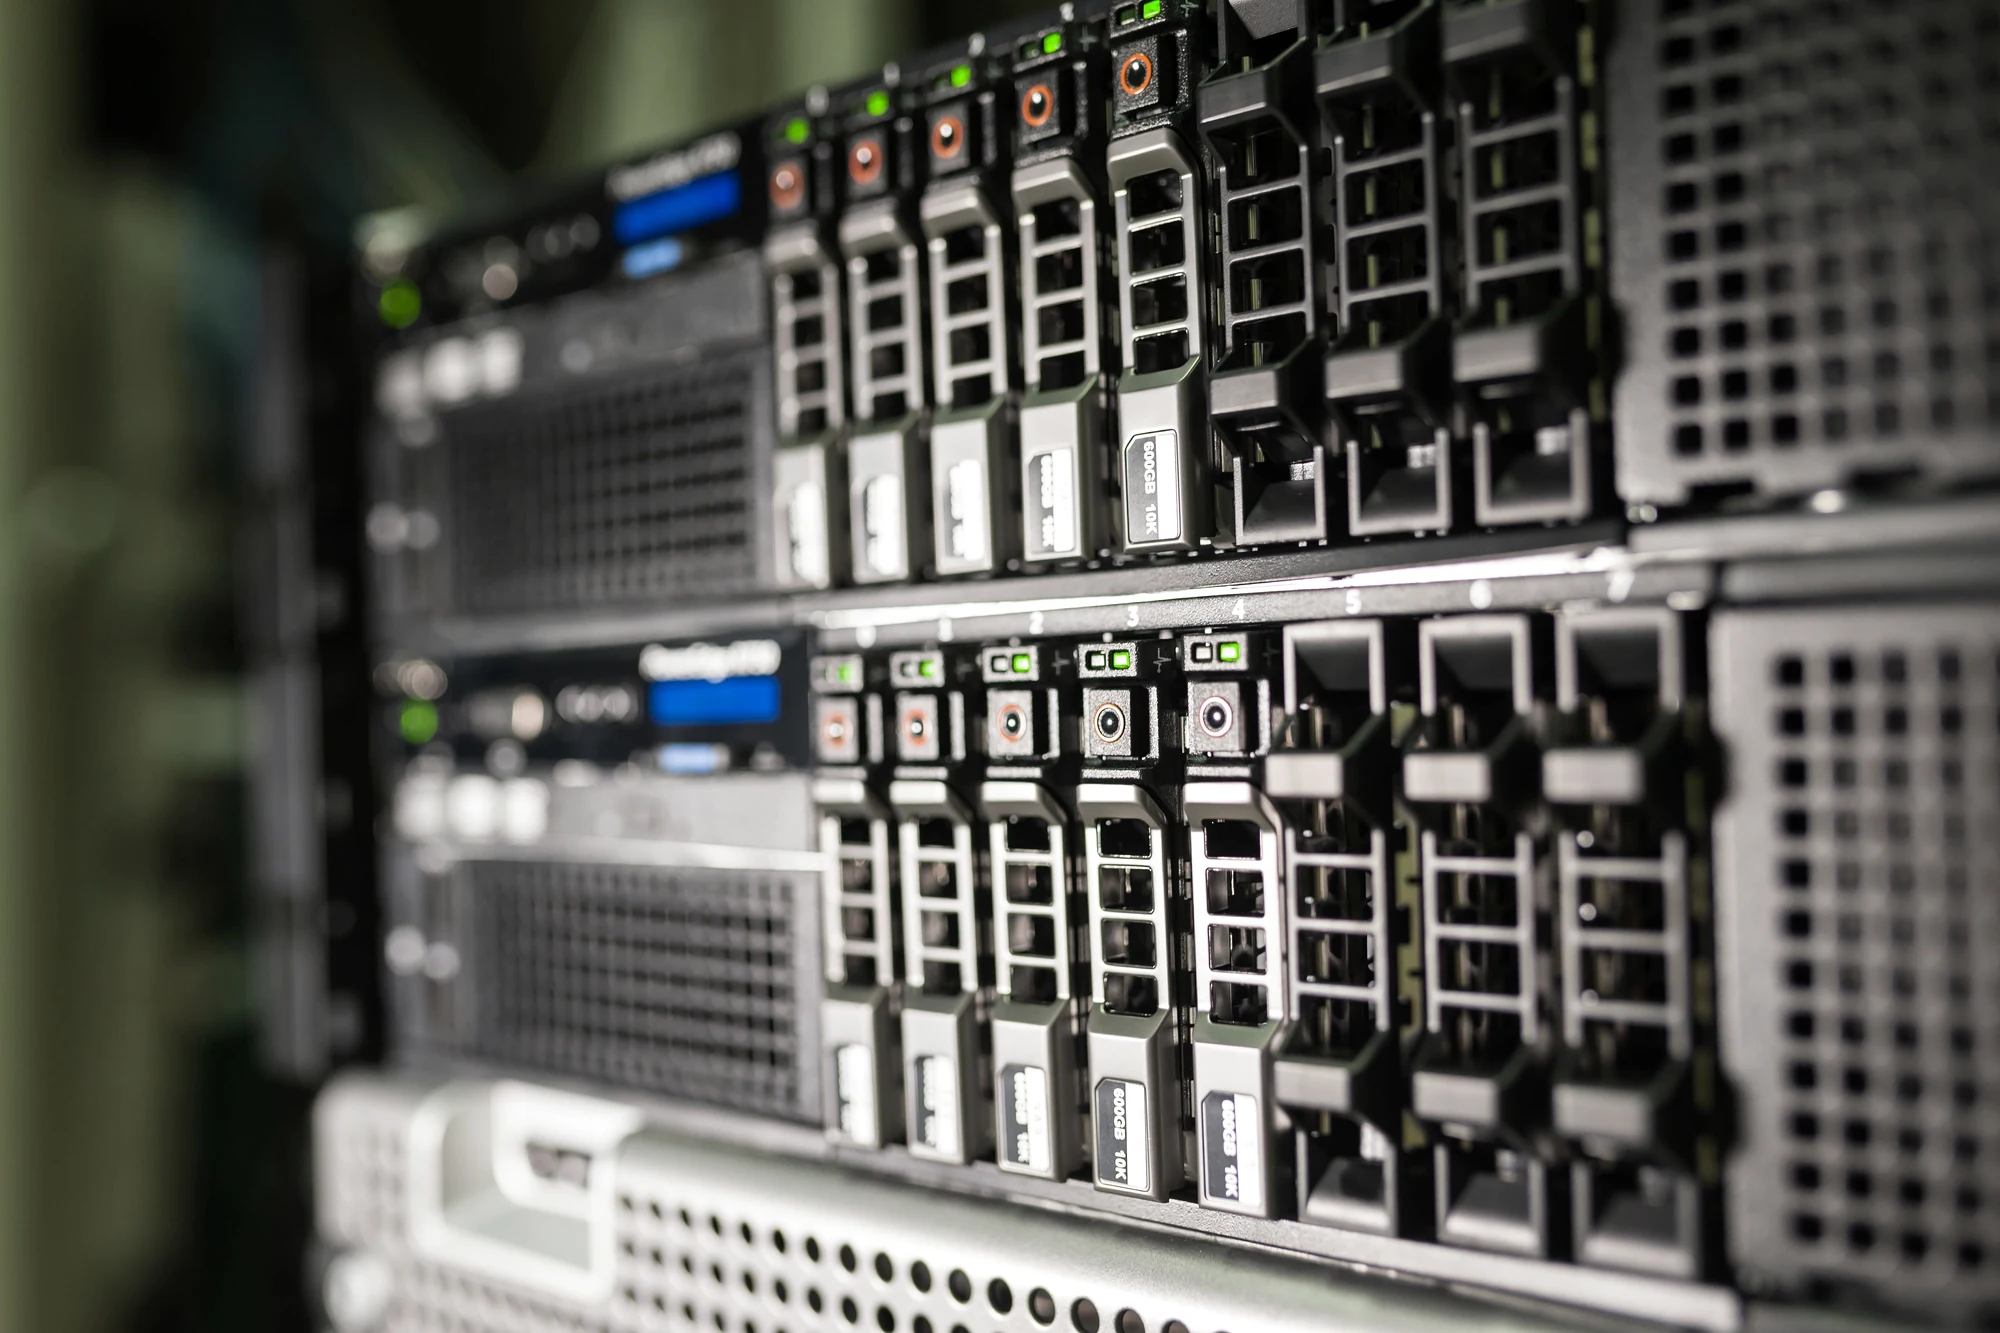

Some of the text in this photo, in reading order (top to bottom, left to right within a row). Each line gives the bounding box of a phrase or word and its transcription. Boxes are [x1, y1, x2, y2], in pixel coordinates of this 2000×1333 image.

[1143, 441, 1157, 535] 600GB 10K
[1231, 598, 1245, 619] 4
[1345, 589, 1362, 614] 5
[1029, 611, 1044, 634] 2
[1127, 604, 1139, 627] 3
[1113, 1088, 1127, 1180] 600GB 10K
[1224, 1165, 1239, 1198] 10K
